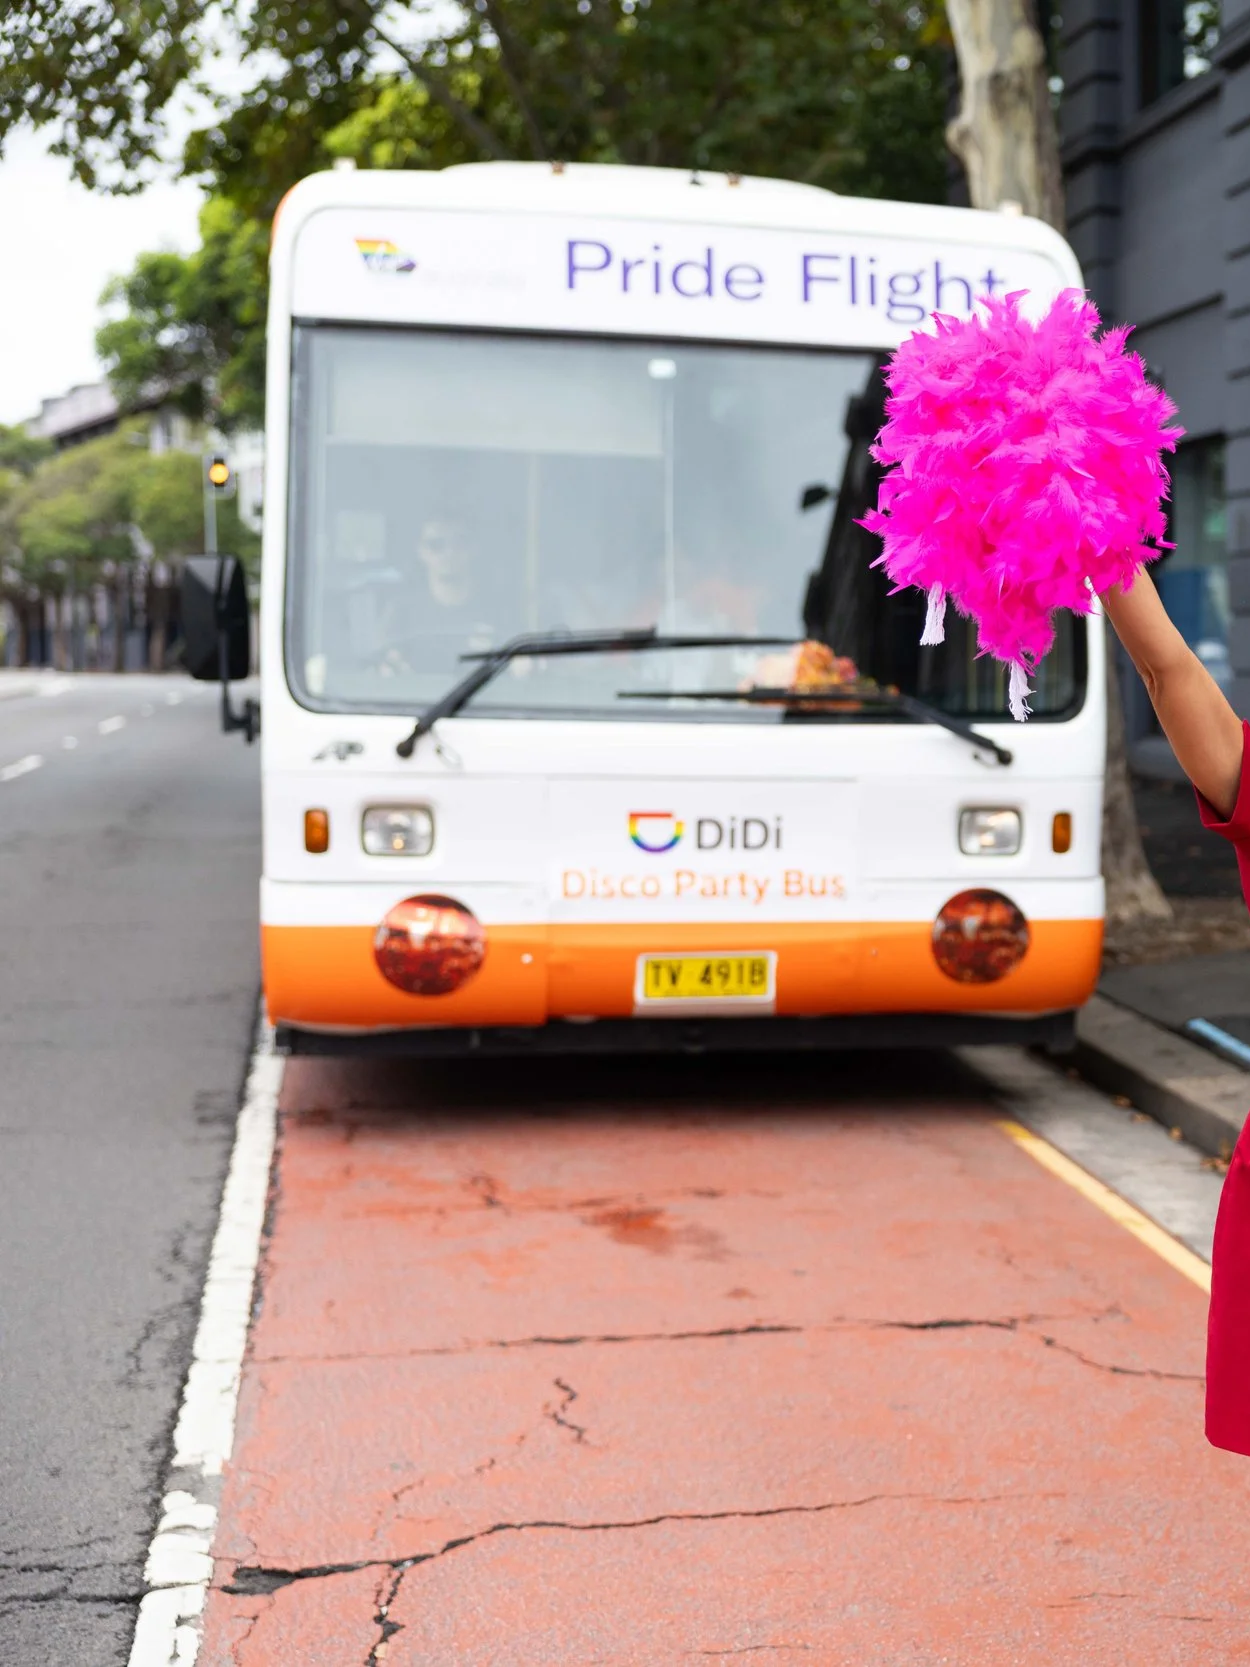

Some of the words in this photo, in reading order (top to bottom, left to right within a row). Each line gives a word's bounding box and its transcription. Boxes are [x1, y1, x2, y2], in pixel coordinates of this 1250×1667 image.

[567, 238, 764, 301] Pride
[696, 816, 782, 851] DiDi
[562, 868, 661, 898] Disco
[675, 869, 770, 904] Party
[784, 869, 846, 898] Bus
[651, 960, 682, 987] TV
